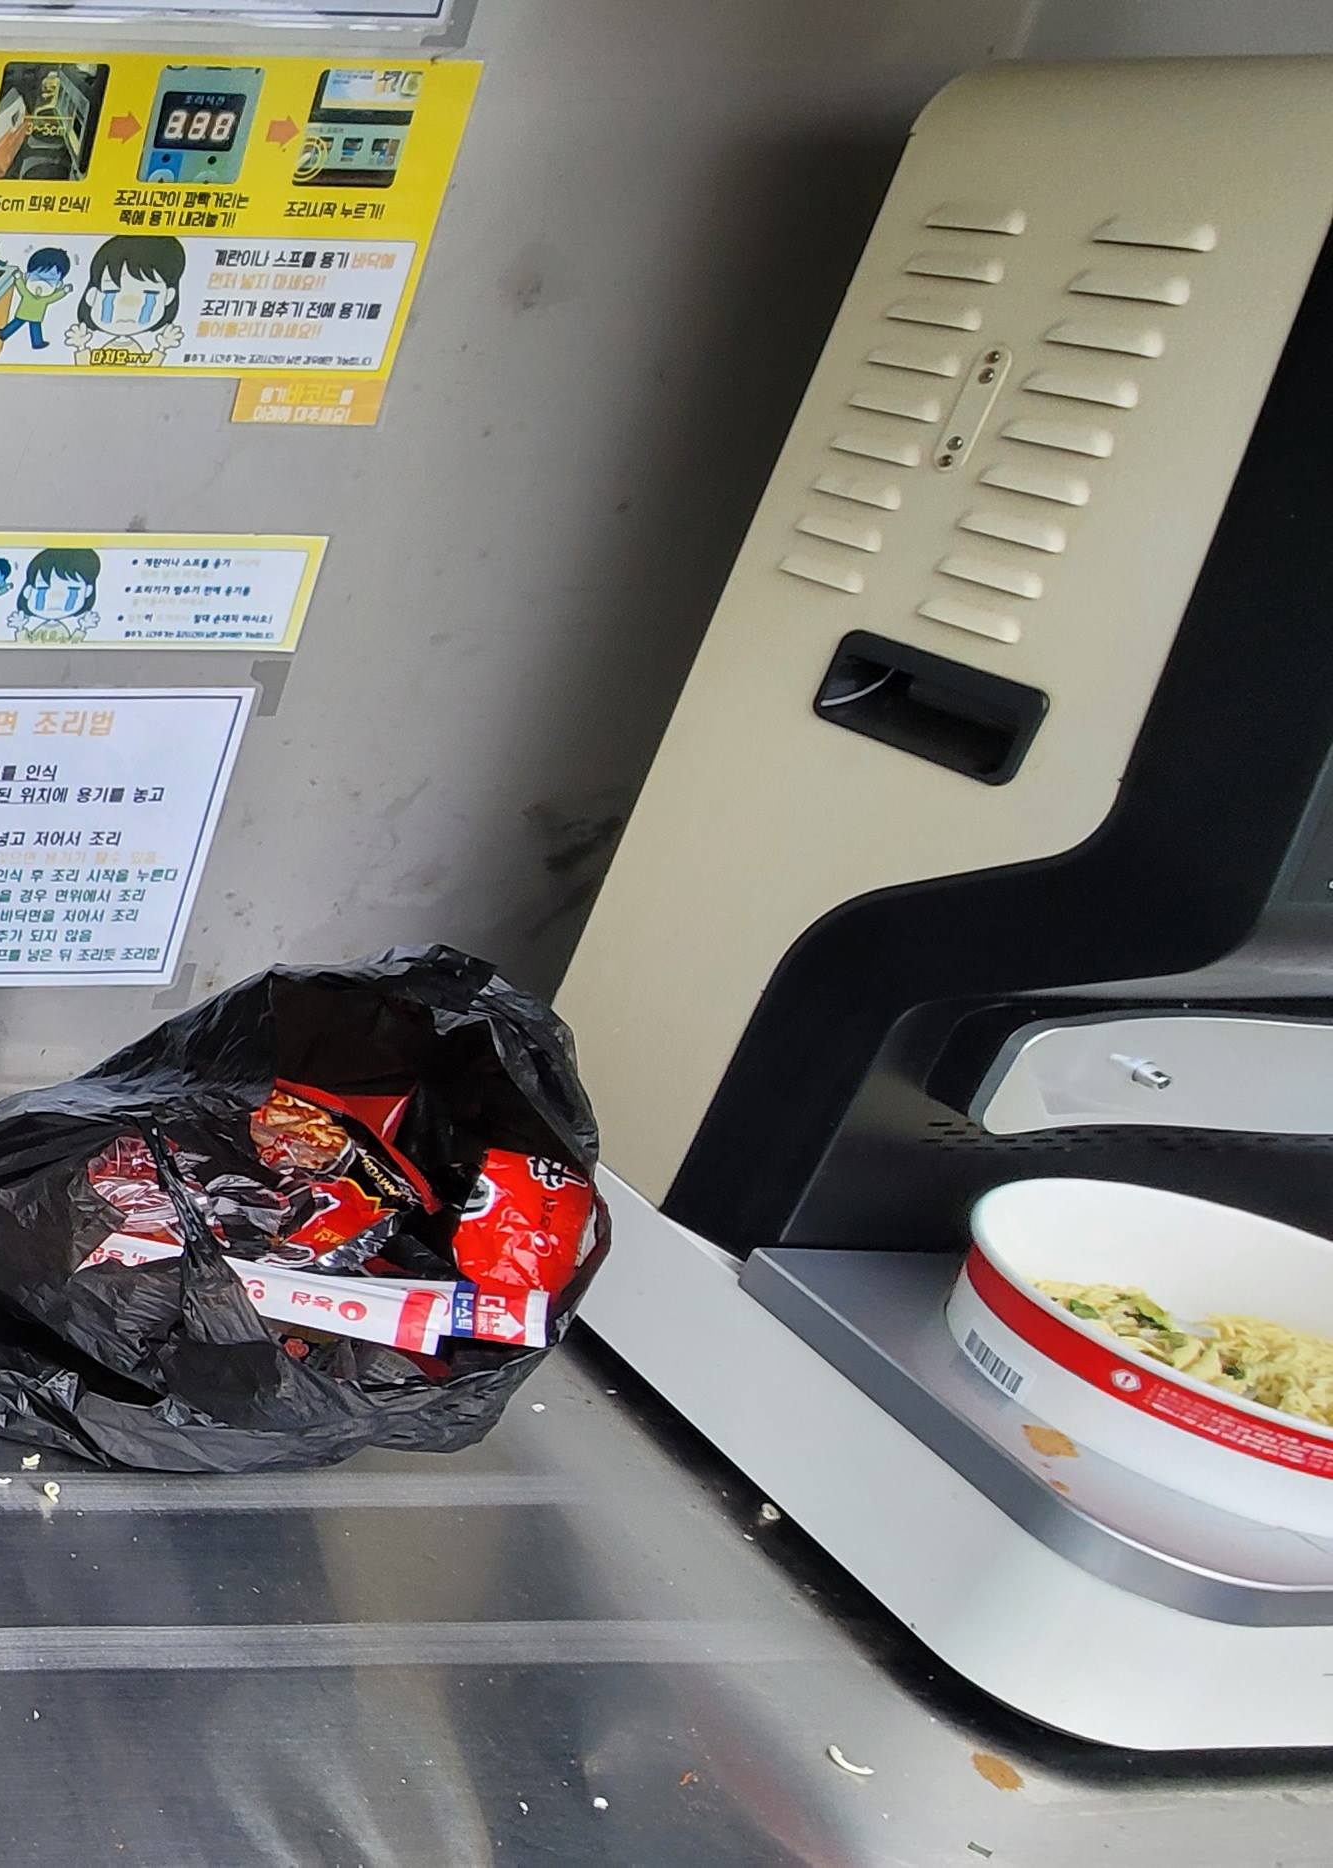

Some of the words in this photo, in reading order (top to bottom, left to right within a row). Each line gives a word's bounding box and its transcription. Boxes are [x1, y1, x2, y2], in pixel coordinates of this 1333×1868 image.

[28, 196, 56, 213] 띄워
[58, 195, 91, 214] 인식!
[113, 189, 180, 208] 조리시간이
[148, 211, 176, 226] 용기
[283, 201, 338, 219] 조리시작
[340, 203, 386, 220] 누르기!
[214, 249, 270, 267] 계란이나
[319, 251, 350, 269] 용기
[200, 299, 257, 317] 조리기가
[260, 301, 304, 318] 멈추기
[306, 302, 336, 319] 전에
[25, 765, 58, 781] 인식
[20, 787, 69, 803] 위치에
[77, 787, 125, 803] 용기를
[133, 787, 165, 803] 놓고
[33, 831, 82, 847] 저어서
[89, 831, 122, 846] 조리
[291, 1290, 335, 1313] 농심
